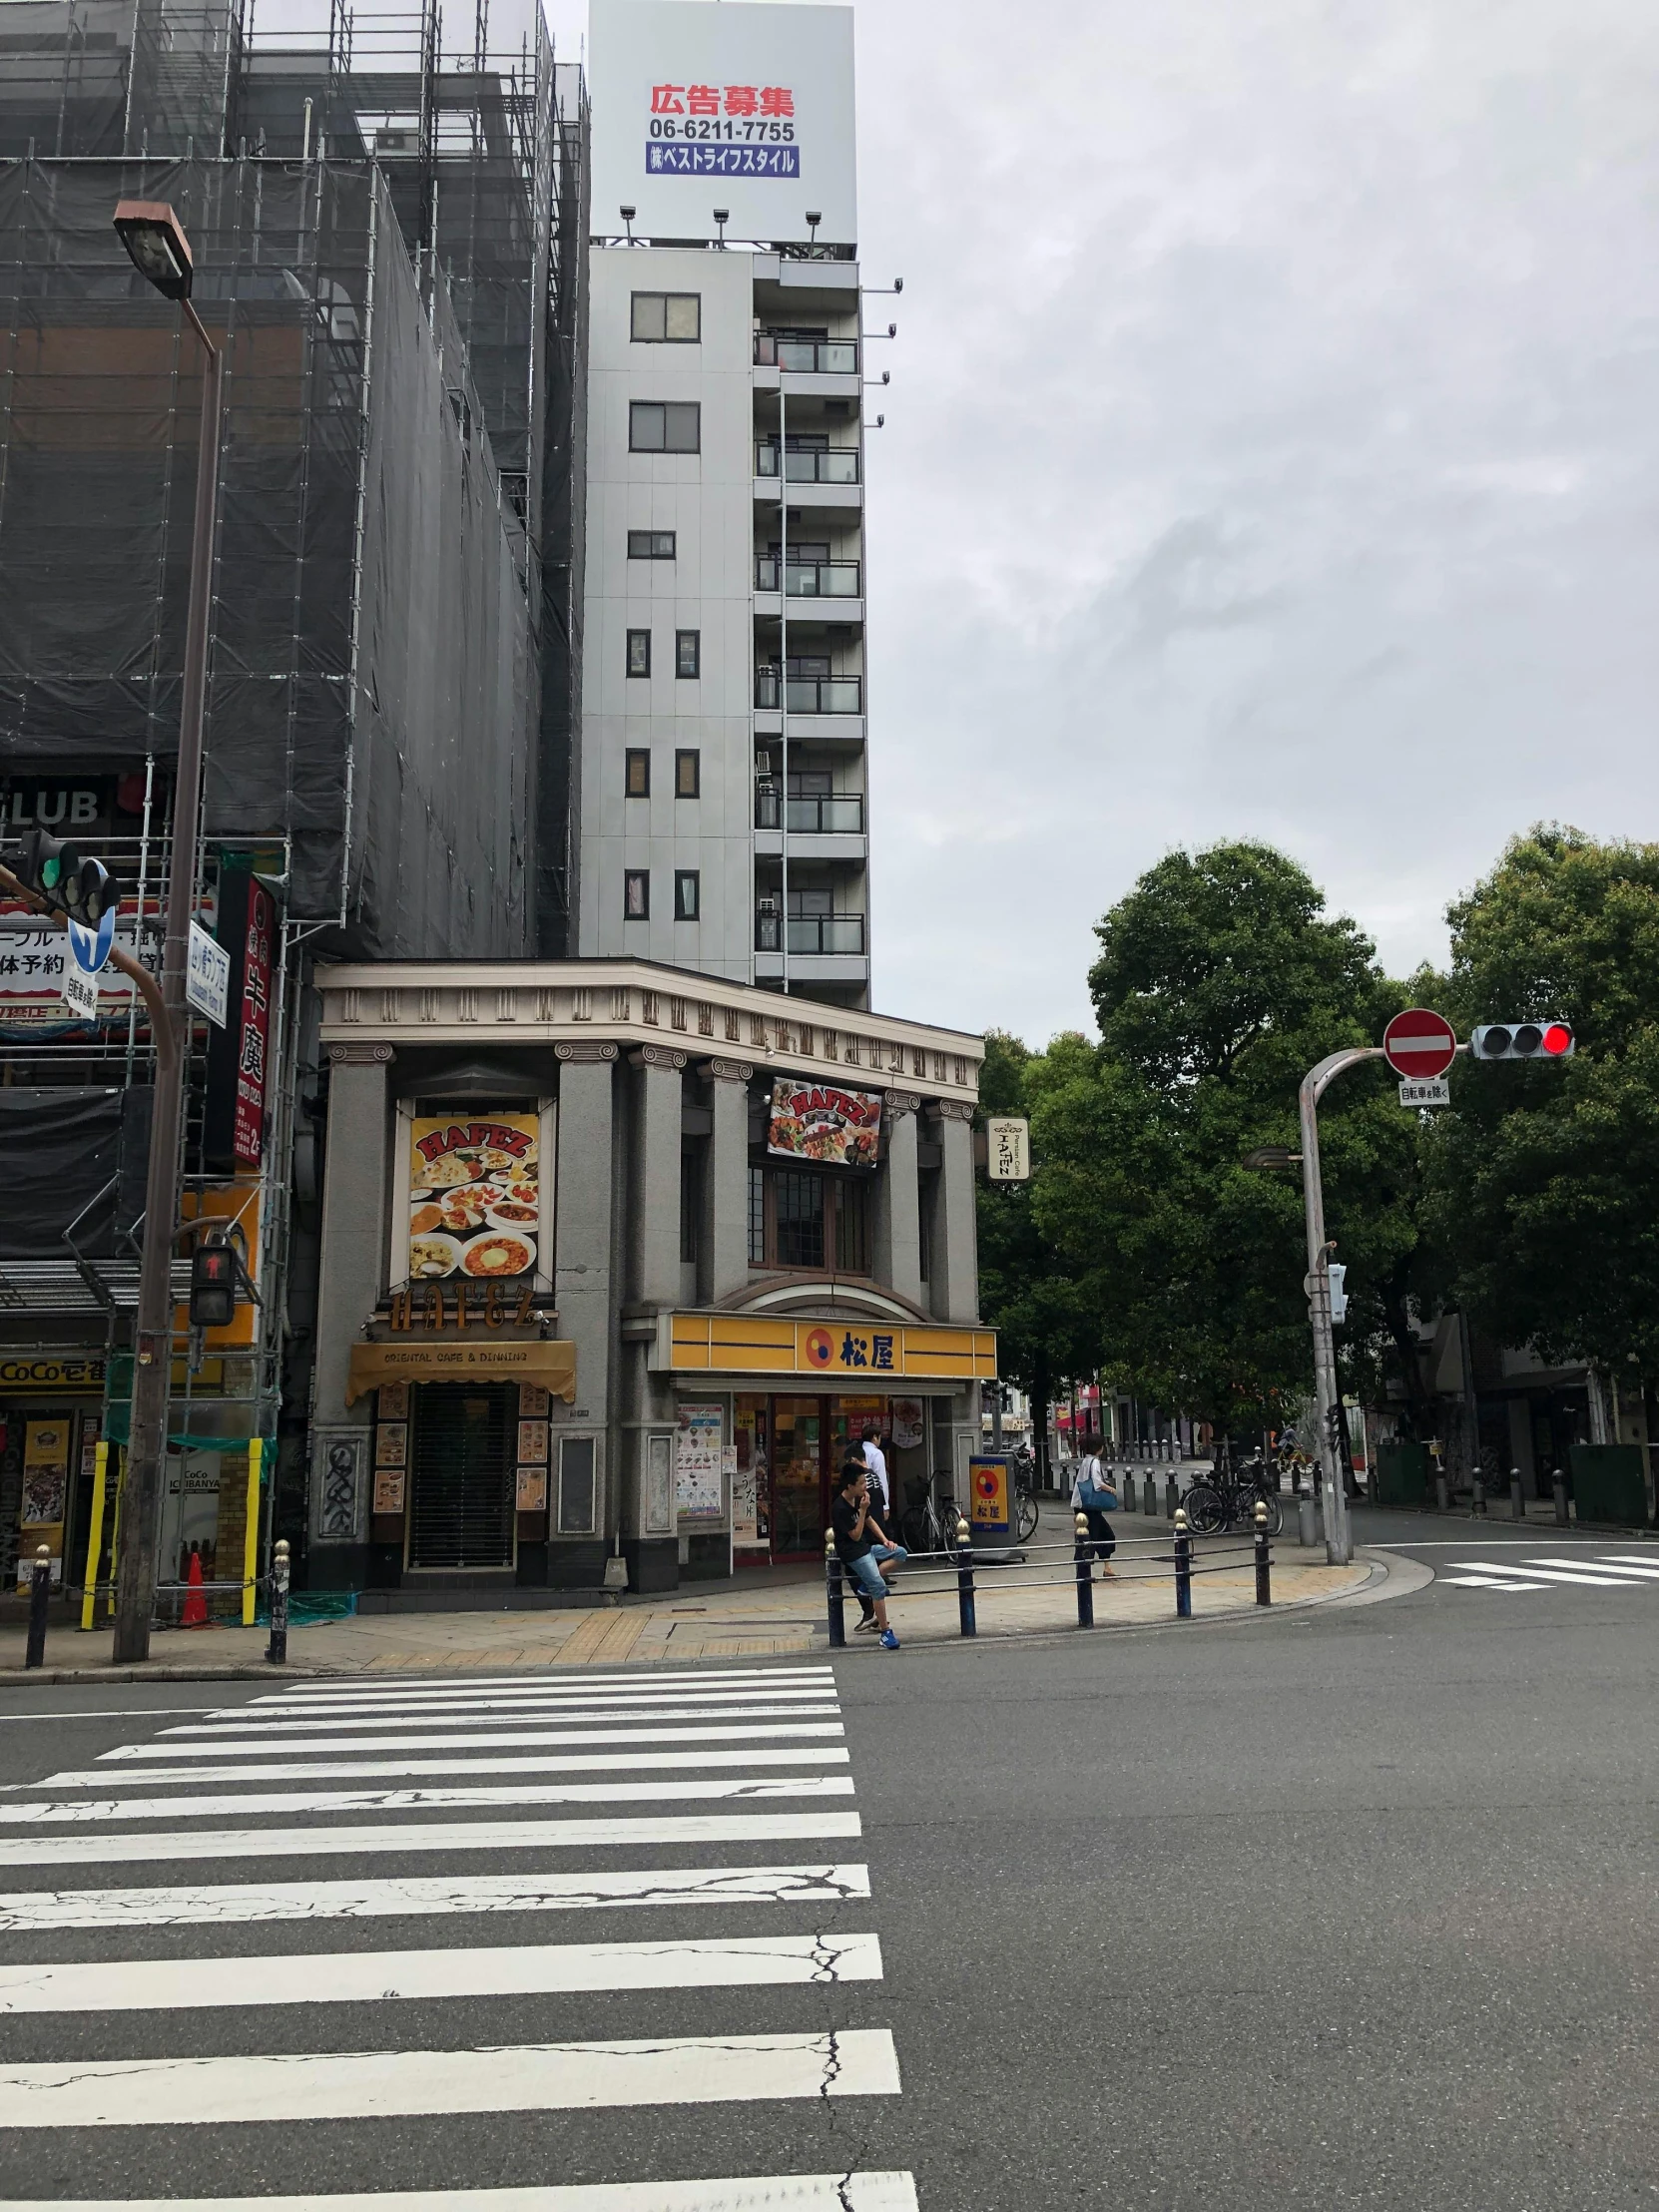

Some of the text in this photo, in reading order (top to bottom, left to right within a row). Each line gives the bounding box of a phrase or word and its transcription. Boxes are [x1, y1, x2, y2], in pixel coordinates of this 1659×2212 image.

[650, 84, 795, 118] 広告募集
[649, 119, 795, 142] 06-6211-7755
[0, 791, 98, 826] LUB
[790, 1088, 866, 1128] HAFEZ
[1401, 1085, 1448, 1101] 自転車を除く
[416, 1122, 535, 1161] HAFEZ
[997, 1134, 1013, 1176] HAFEZ
[389, 1282, 536, 1332] HAFEZ
[384, 1352, 527, 1364] ORIENTAL CAFE & DINNING
[839, 1332, 894, 1371] 松屋
[170, 1479, 221, 1488] ICIBANYA
[977, 1504, 1000, 1519] 松屋
